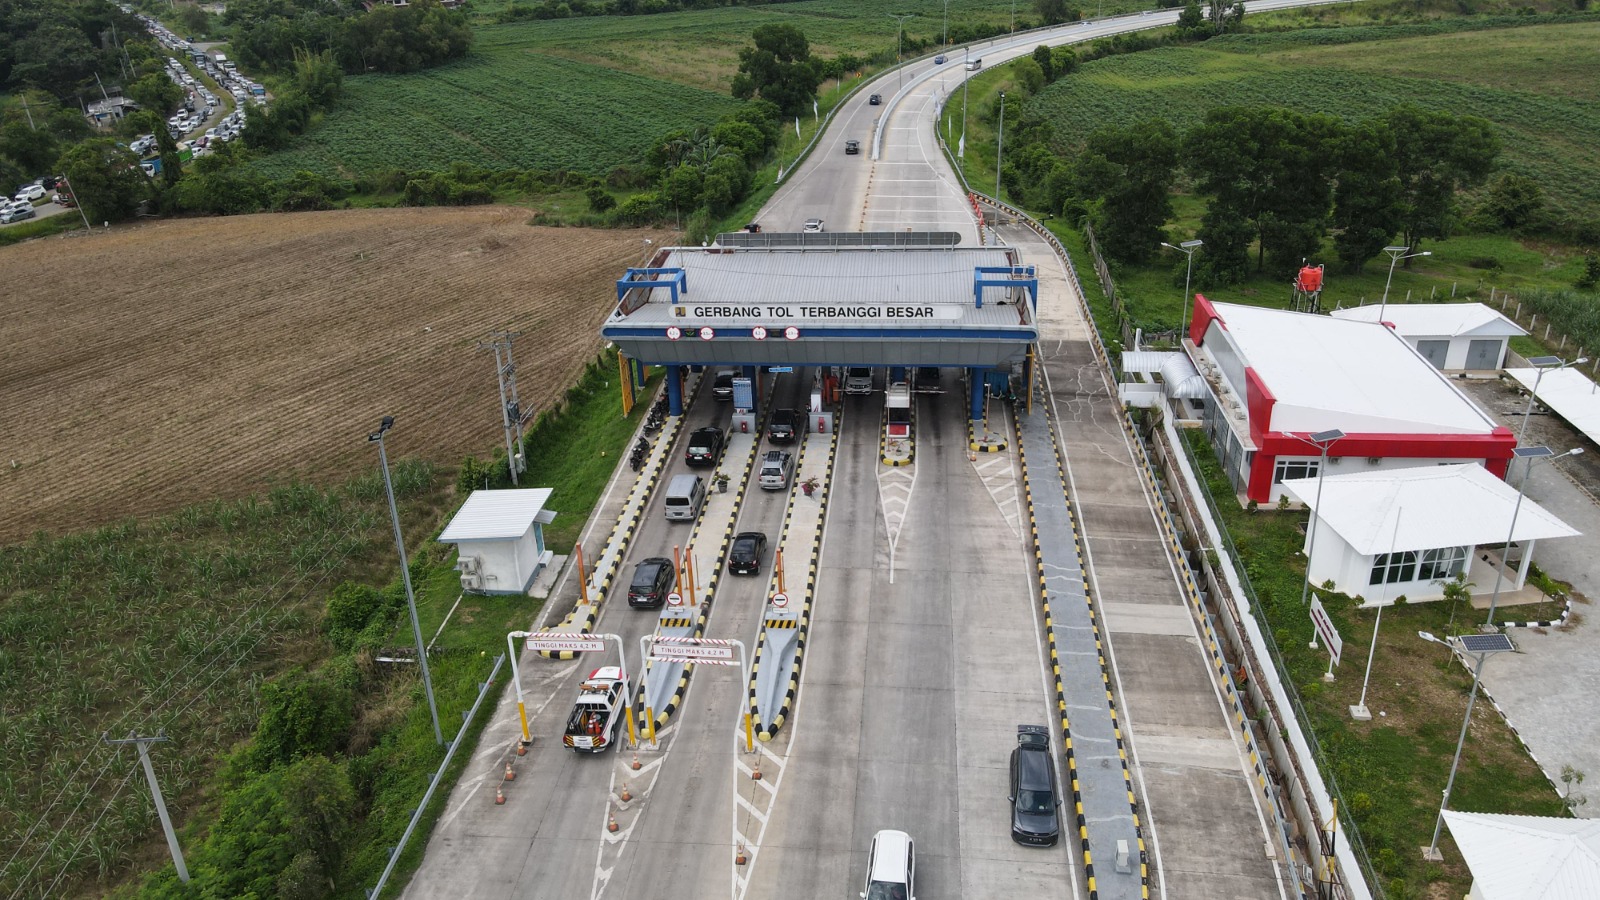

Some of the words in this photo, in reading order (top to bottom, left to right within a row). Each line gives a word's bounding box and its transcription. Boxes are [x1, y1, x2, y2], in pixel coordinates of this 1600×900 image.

[694, 307, 761, 317] GERBANG
[767, 306, 793, 317] TOL
[800, 306, 881, 317] TERBANGGI
[887, 306, 934, 317] BESAR
